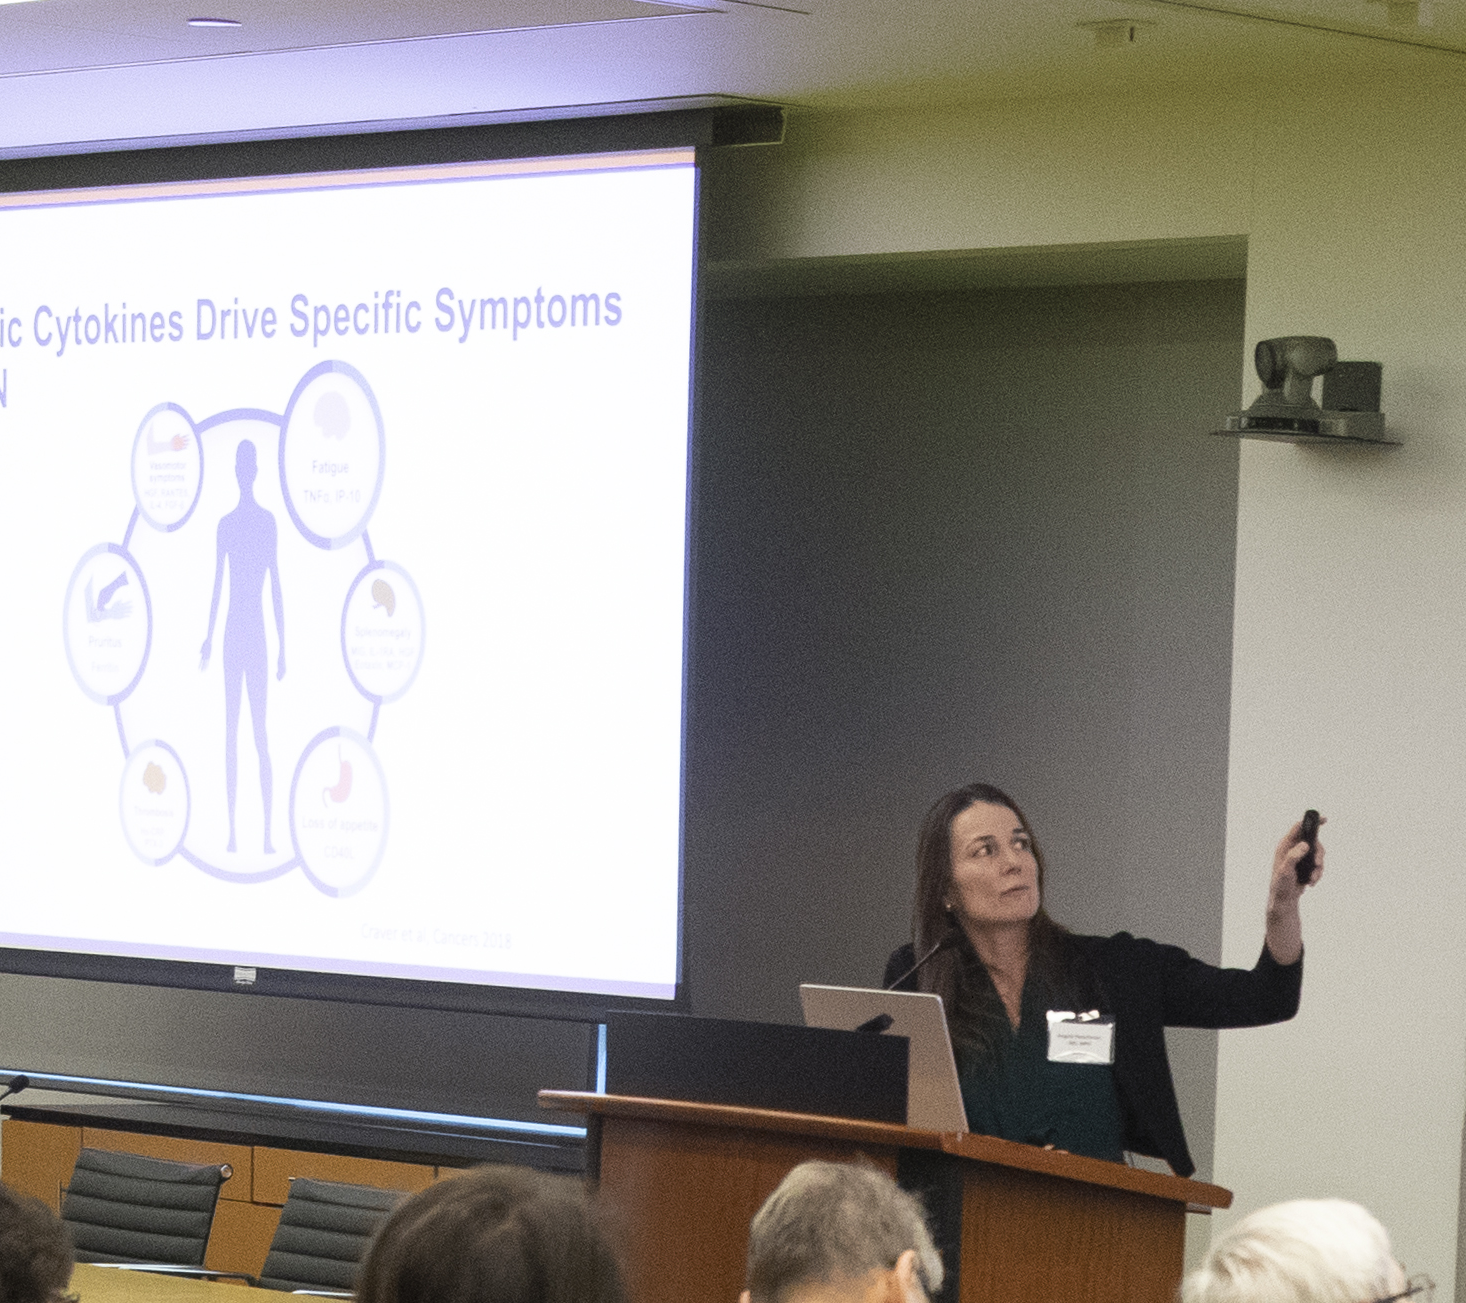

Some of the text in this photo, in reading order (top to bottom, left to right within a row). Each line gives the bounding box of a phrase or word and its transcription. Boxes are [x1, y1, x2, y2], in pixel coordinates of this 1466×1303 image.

[32, 301, 184, 358] Cytokines
[195, 296, 279, 341] Drive
[289, 289, 423, 348] Specific
[433, 284, 623, 344] Symptoms
[311, 459, 349, 477] Fatigue
[302, 816, 379, 834] Loss of appetite
[360, 923, 398, 941] Craver
[433, 929, 480, 948] Cancers
[482, 931, 512, 950] 2018
